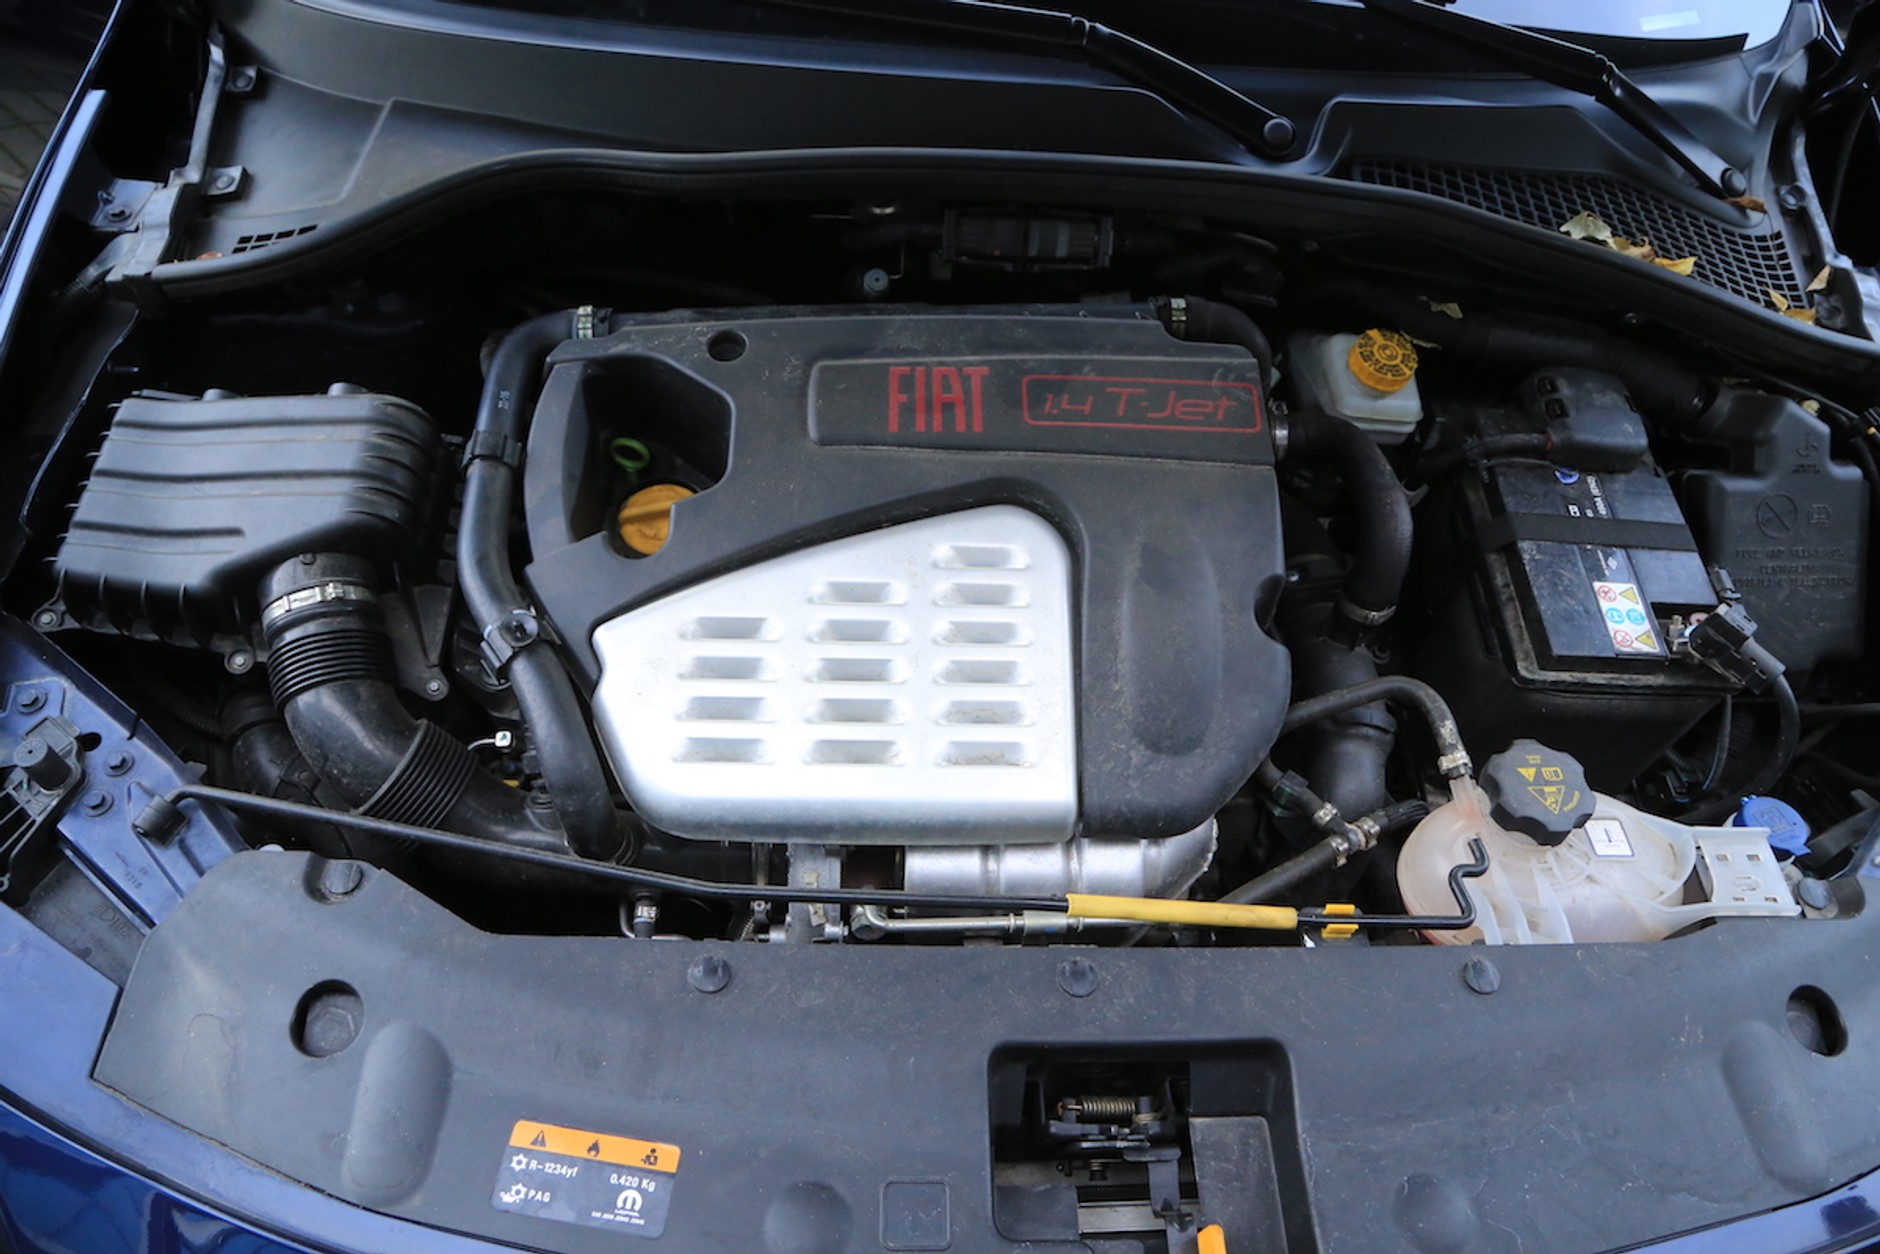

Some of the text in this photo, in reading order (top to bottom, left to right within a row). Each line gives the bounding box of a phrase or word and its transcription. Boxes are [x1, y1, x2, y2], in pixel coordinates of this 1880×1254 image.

[888, 367, 989, 433] FIAT
[1043, 387, 1238, 420] 1.4 T-Jet
[529, 1160, 578, 1178] R-1234yf
[610, 1173, 656, 1192] 0.420 Kg
[528, 1189, 551, 1202] PAG
